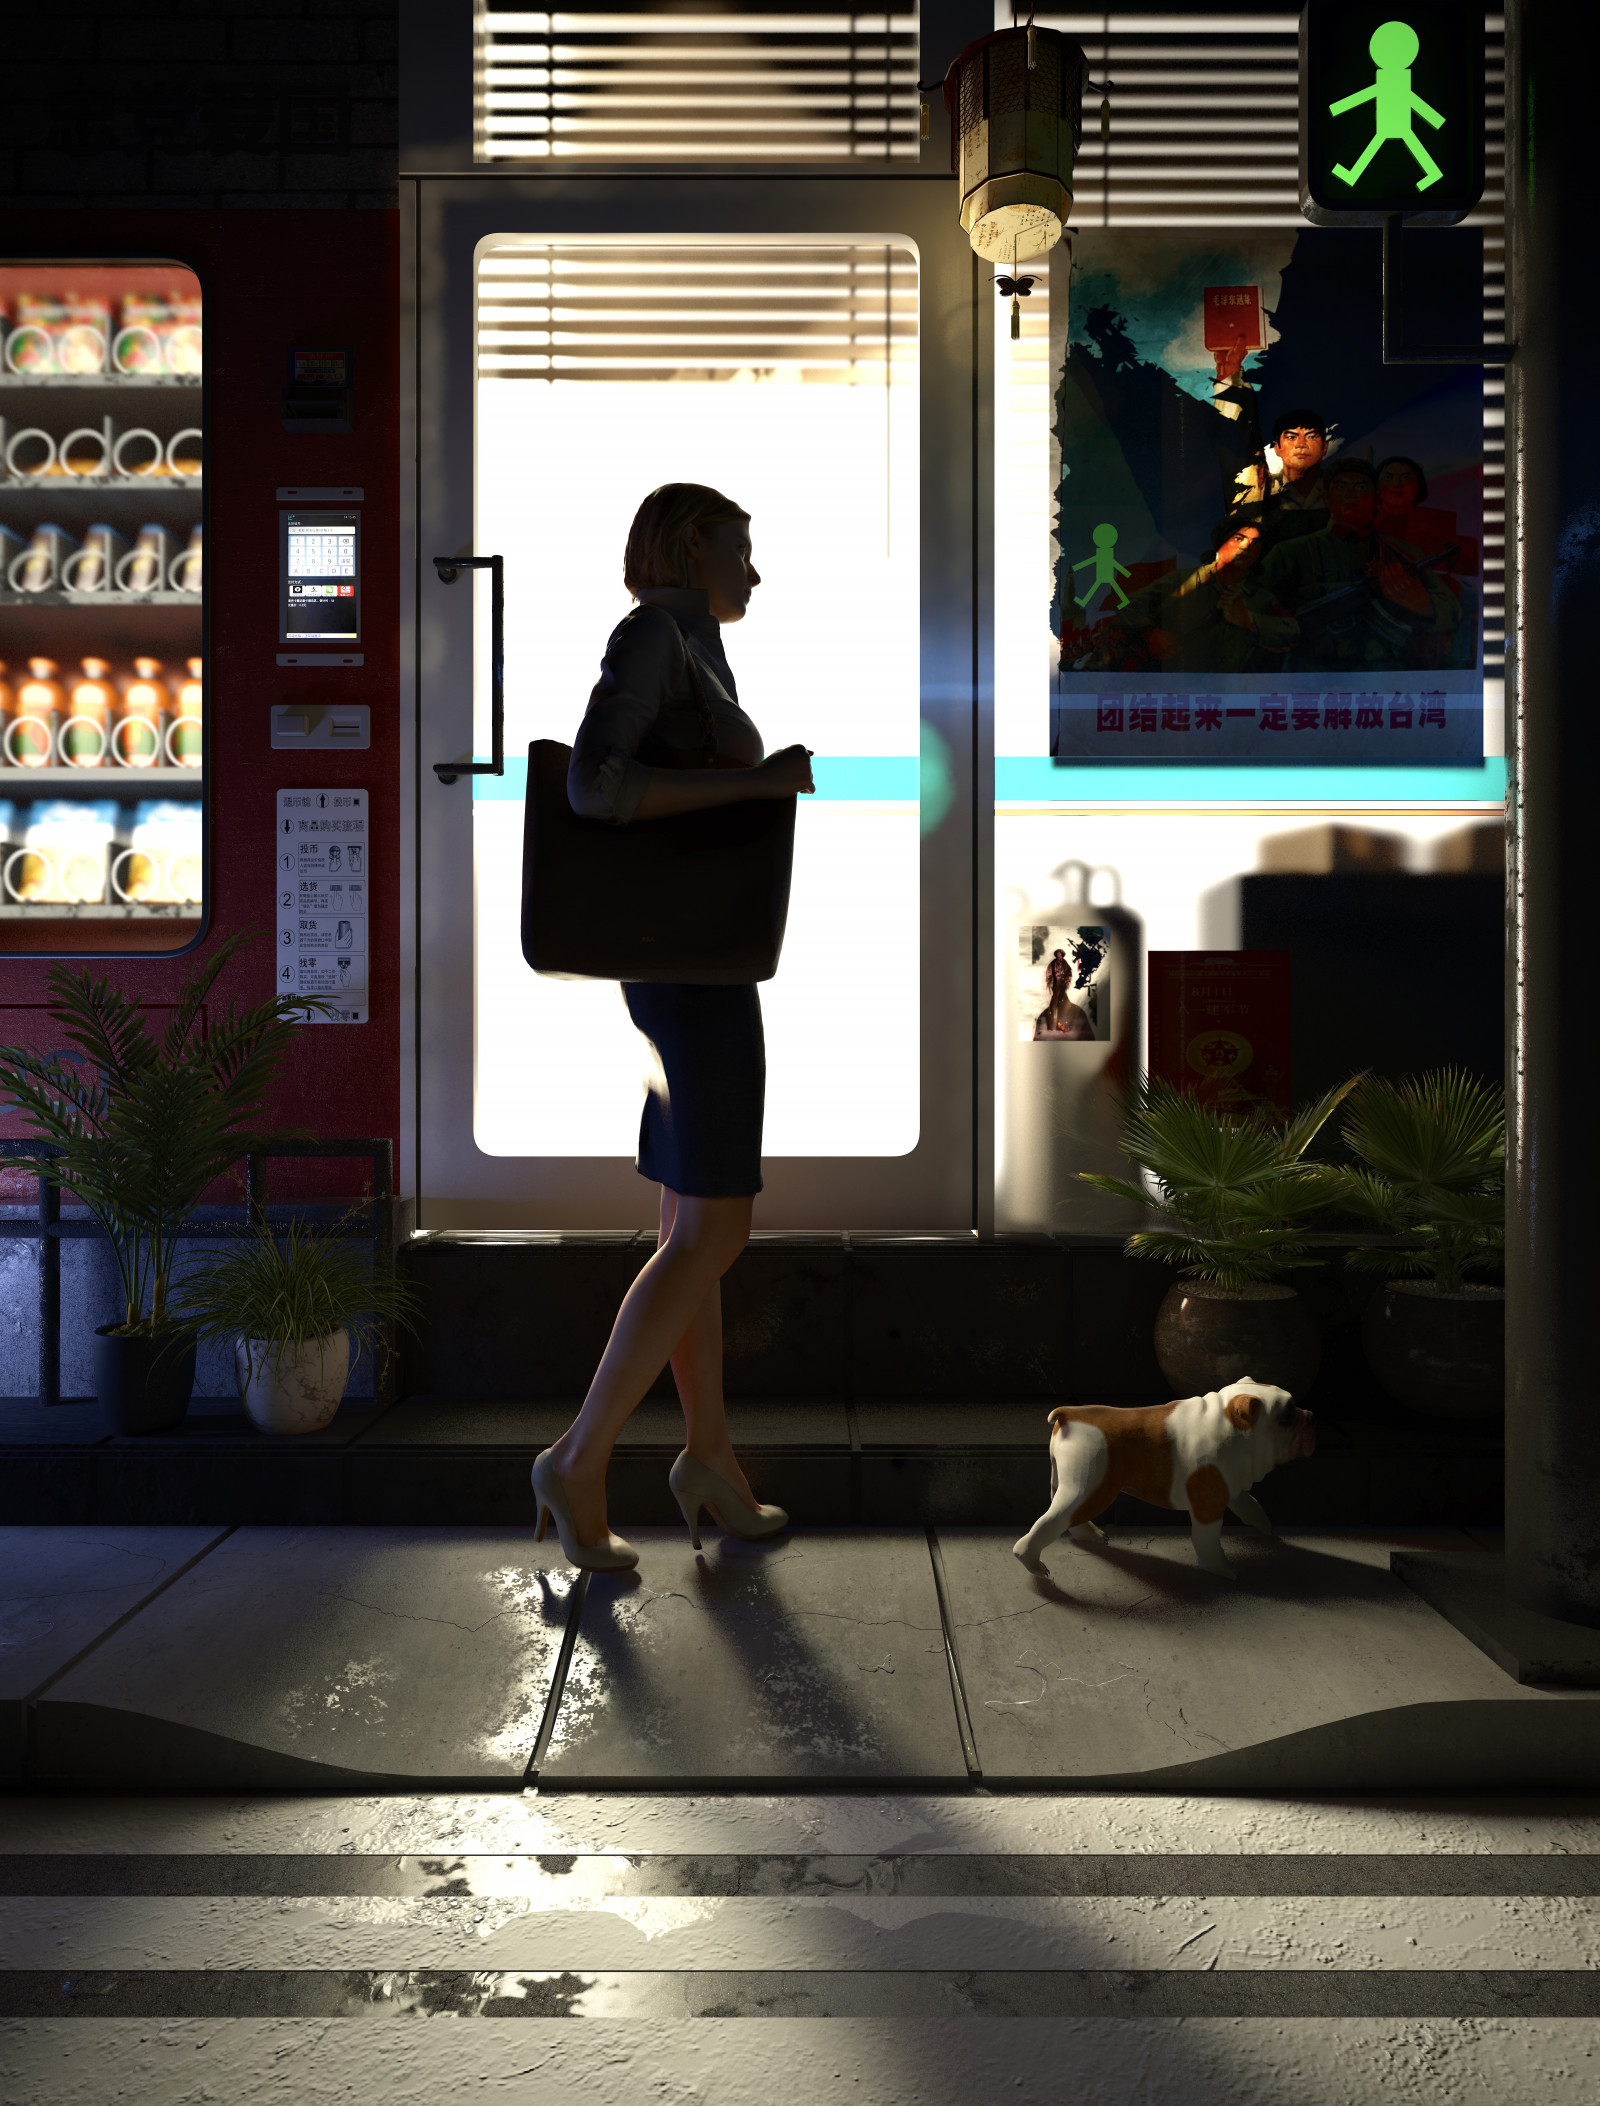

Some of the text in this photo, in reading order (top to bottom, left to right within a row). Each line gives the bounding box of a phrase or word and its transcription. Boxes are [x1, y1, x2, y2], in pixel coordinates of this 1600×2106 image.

[1212, 293, 1252, 307] 毛泽东选集
[1096, 691, 1447, 732] 团结起来一定要解放台湾
[298, 820, 365, 832] 商品购买流程
[300, 844, 318, 854] 投币
[299, 881, 318, 892] 选货
[299, 920, 317, 930] 取货
[299, 957, 317, 968] 找零
